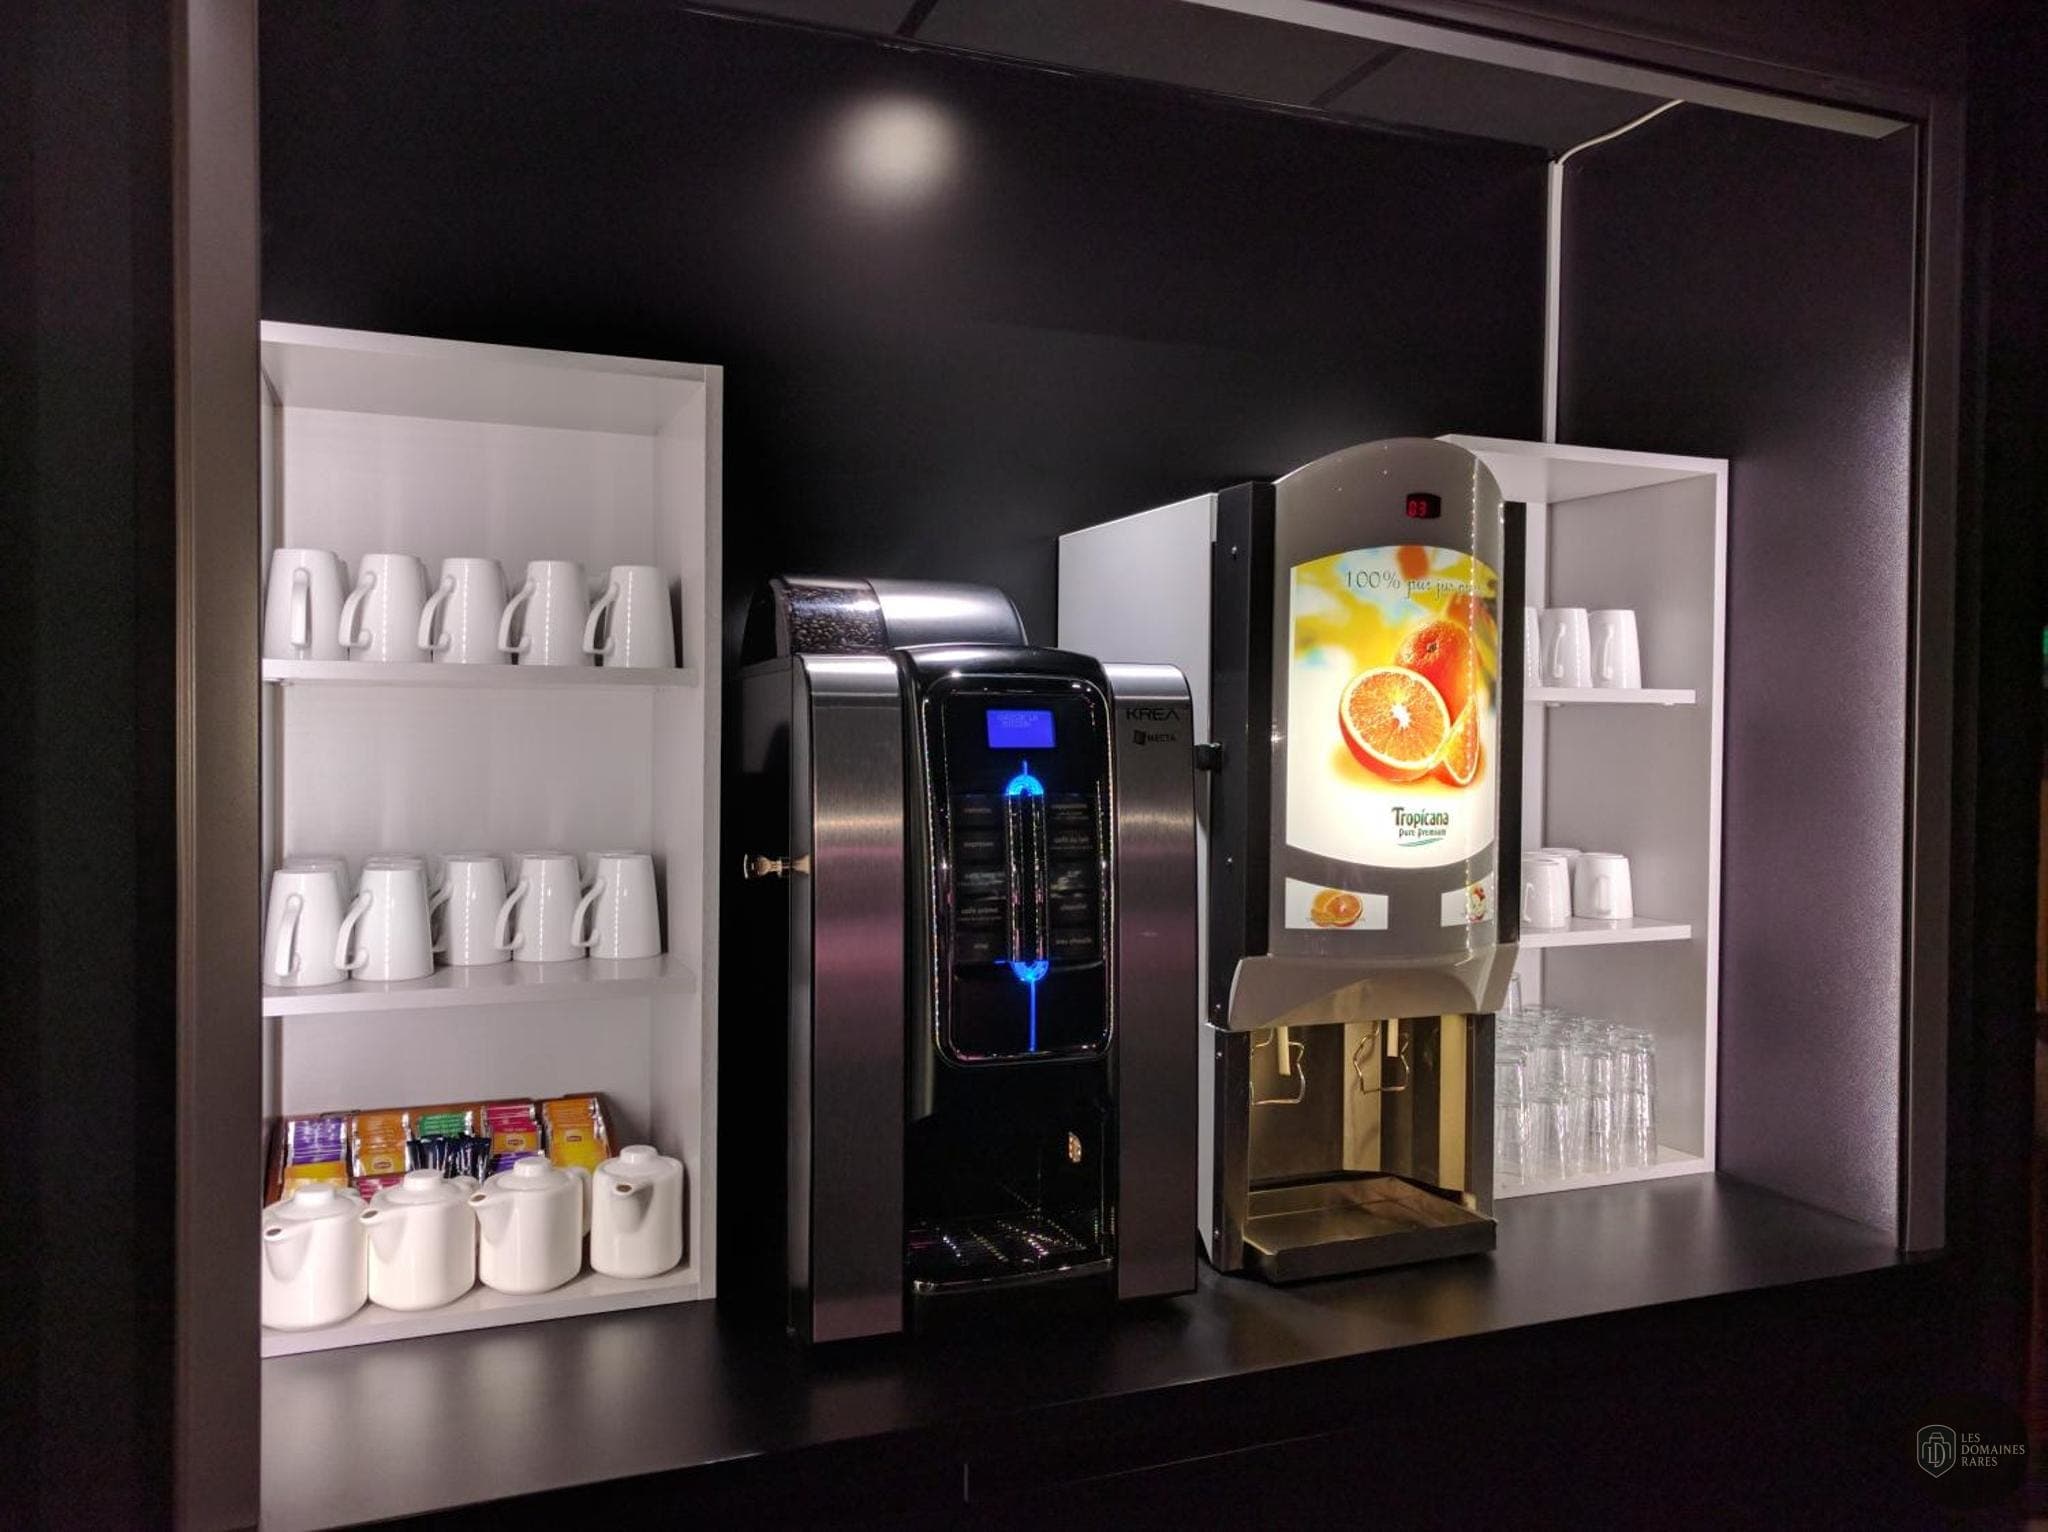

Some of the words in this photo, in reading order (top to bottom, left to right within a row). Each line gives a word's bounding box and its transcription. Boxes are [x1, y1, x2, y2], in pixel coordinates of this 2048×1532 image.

[1347, 570, 1400, 590] 100%
[1126, 707, 1180, 722] KREA
[1392, 806, 1449, 828] Tropicana
